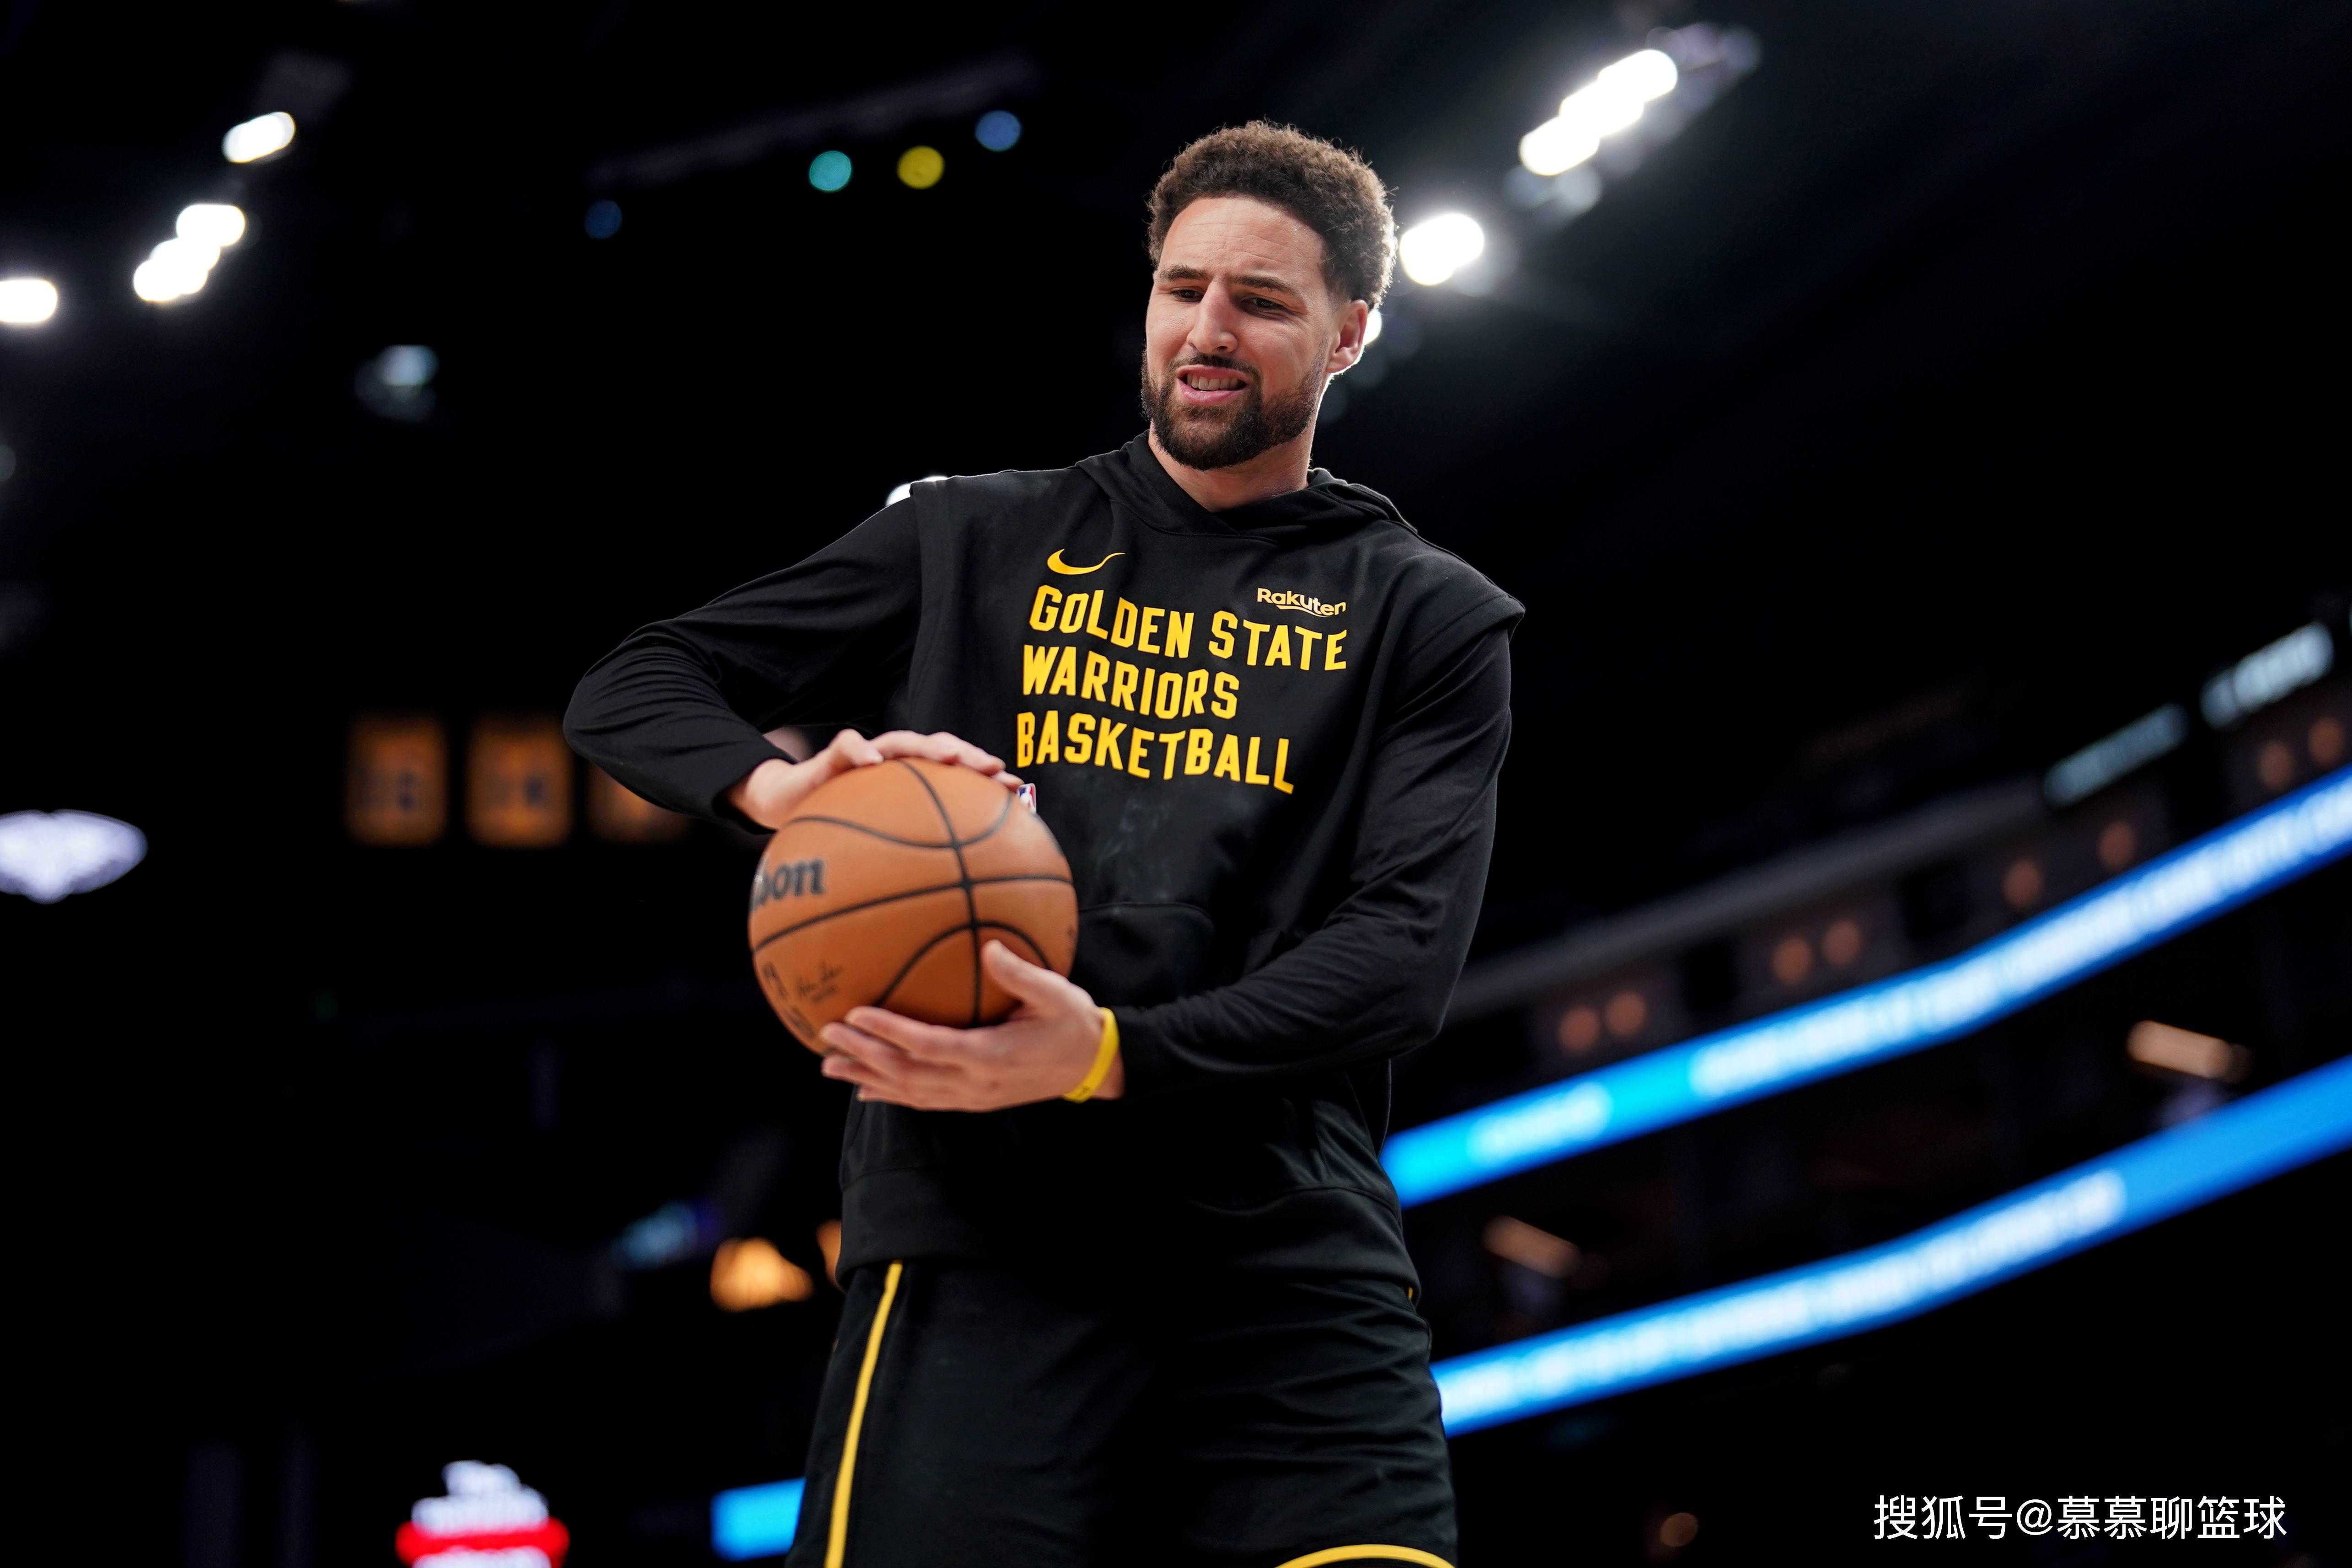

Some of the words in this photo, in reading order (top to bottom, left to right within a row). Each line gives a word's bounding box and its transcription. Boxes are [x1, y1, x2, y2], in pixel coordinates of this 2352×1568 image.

[1029, 584, 1195, 659] GOLDEN
[1208, 610, 1347, 671] STATE
[1257, 587, 1347, 617] Rakuten
[1022, 644, 1240, 720] WARRIORS
[1016, 710, 1295, 794] BASKETBALL
